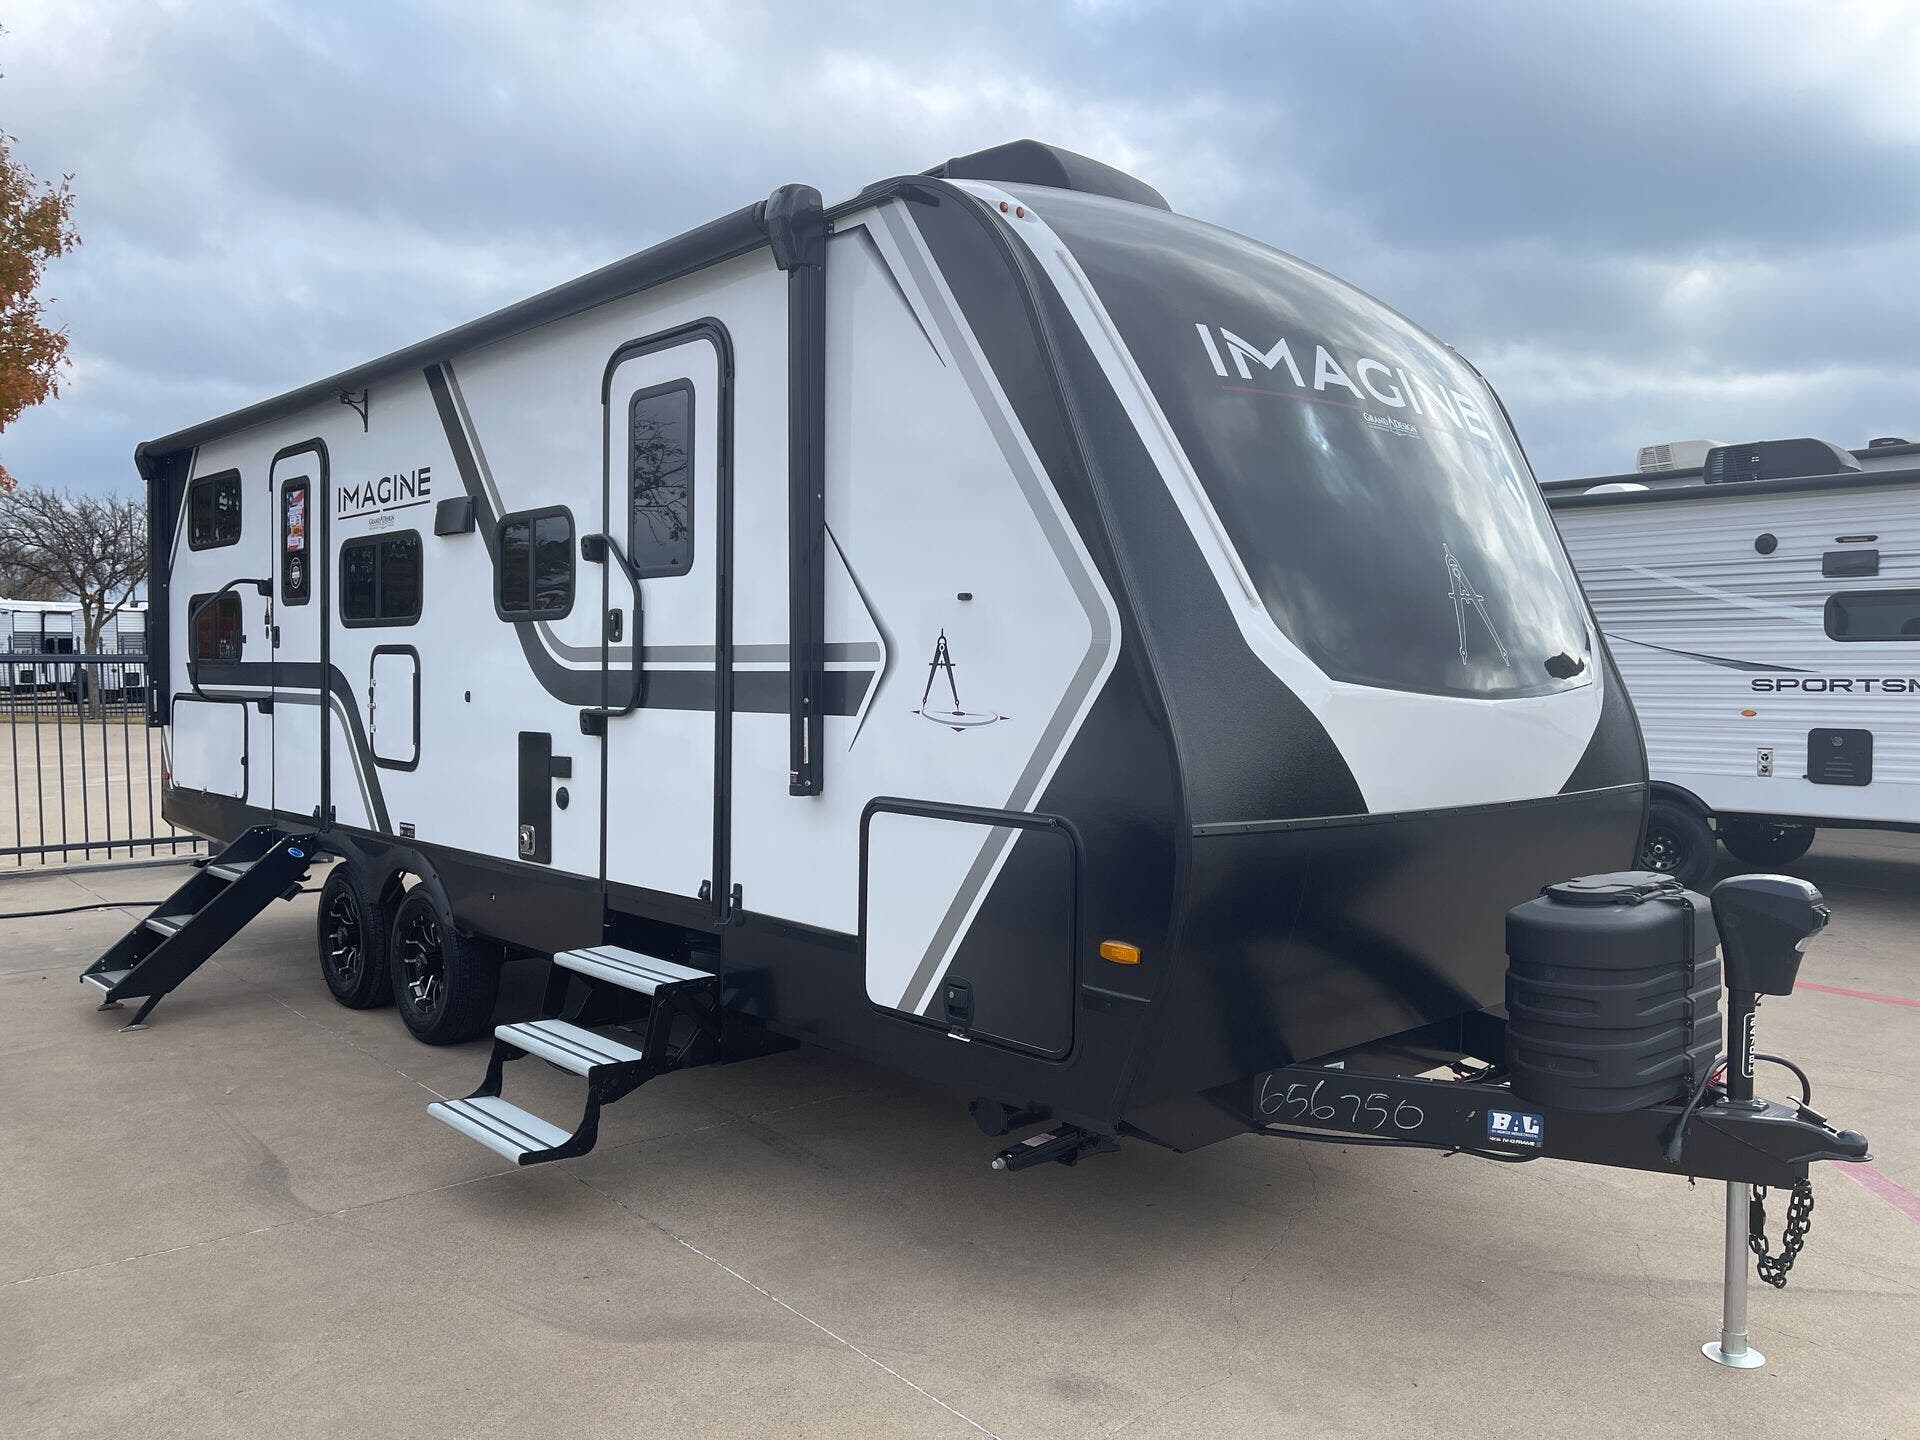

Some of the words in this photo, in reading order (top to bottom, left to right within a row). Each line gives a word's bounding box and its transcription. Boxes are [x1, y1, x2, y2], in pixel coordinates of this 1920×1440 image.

[1196, 323, 1491, 441] IMAGINE
[338, 467, 431, 512] IMAGINE
[1260, 1074, 1424, 1130] 656750
[1492, 1113, 1539, 1133] BAL
